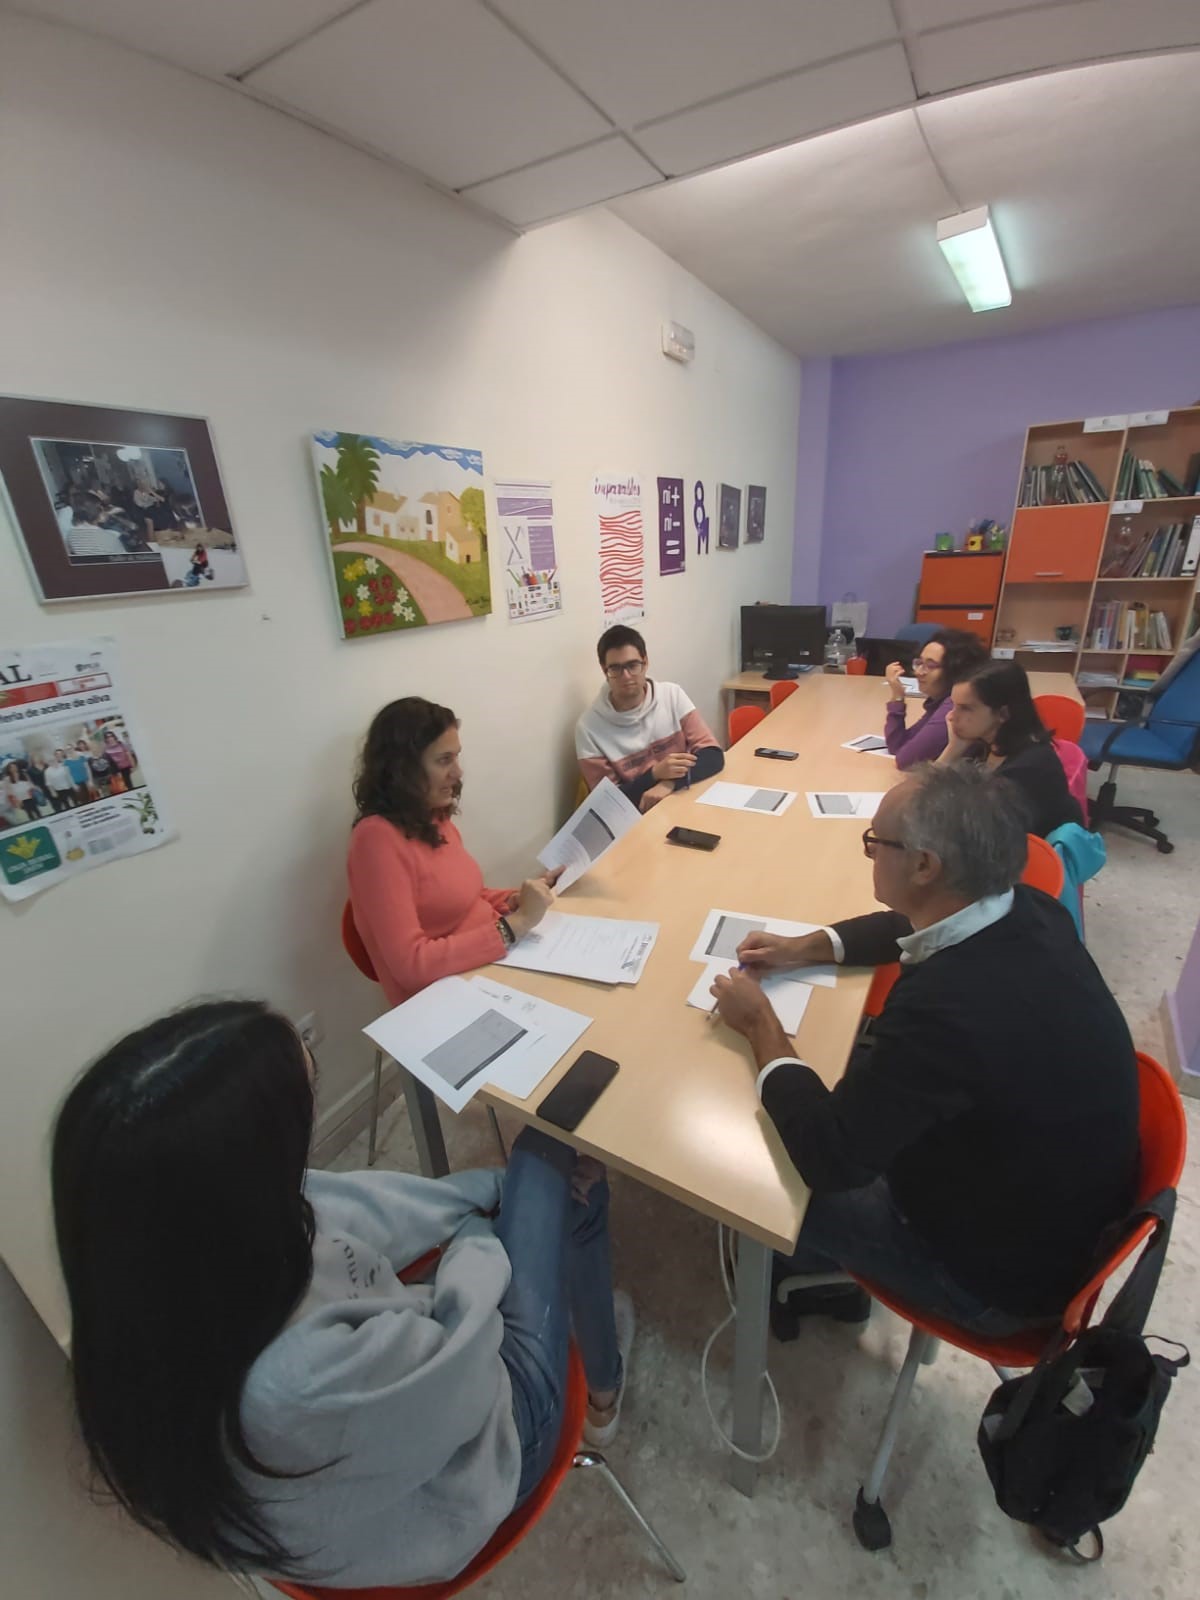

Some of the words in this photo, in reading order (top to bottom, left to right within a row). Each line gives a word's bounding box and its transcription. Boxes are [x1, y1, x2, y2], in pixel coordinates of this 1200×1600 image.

[25, 708, 39, 718] de
[40, 702, 71, 715] aceite
[72, 698, 86, 708] de
[87, 694, 110, 705] oliva
